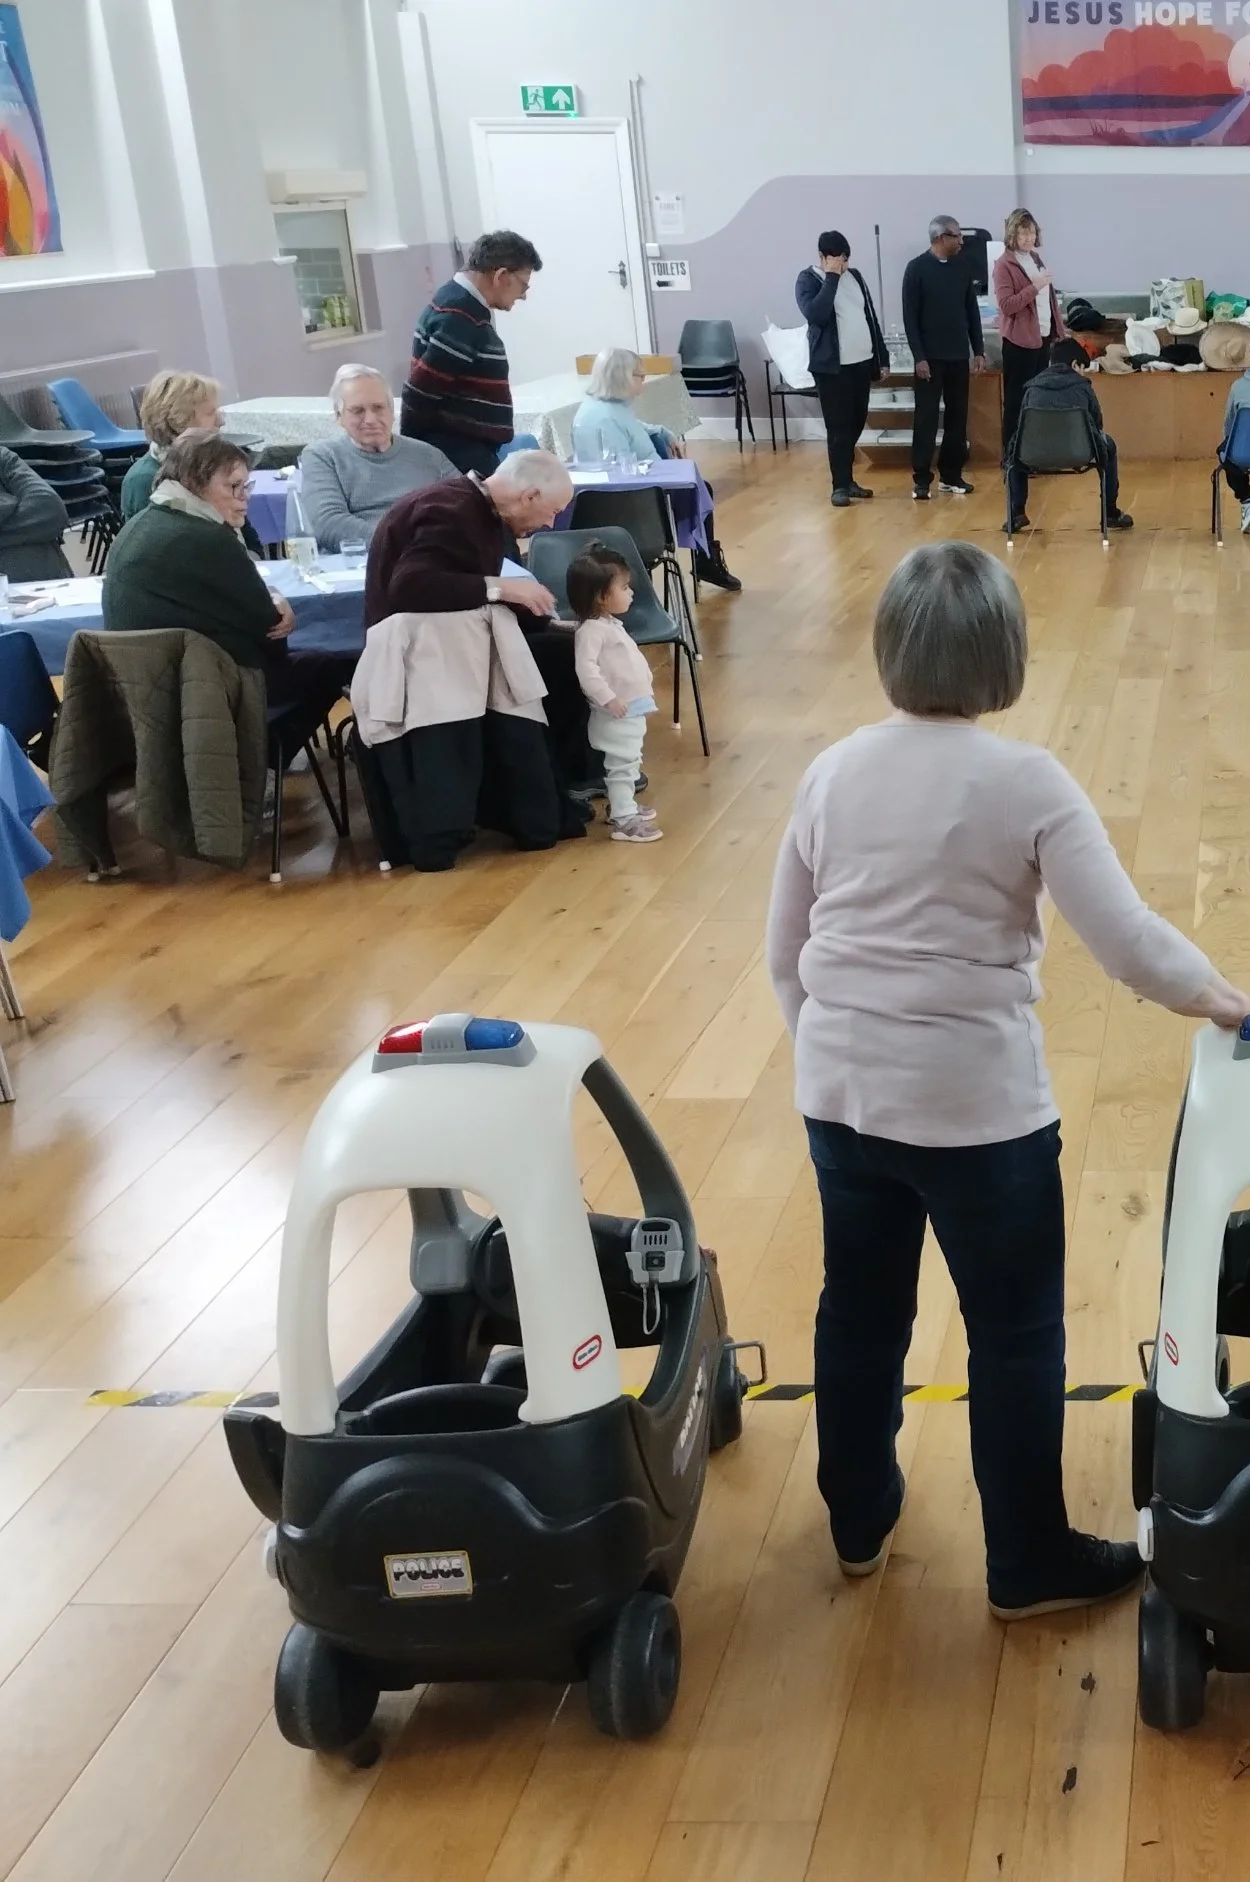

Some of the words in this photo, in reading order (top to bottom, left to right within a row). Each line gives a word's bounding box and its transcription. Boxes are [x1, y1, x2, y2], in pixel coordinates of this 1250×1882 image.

[1028, 1, 1123, 25] JESUS
[1134, 1, 1213, 26] HOPE
[651, 261, 687, 276] TOILETS
[392, 1557, 465, 1582] POLICE
